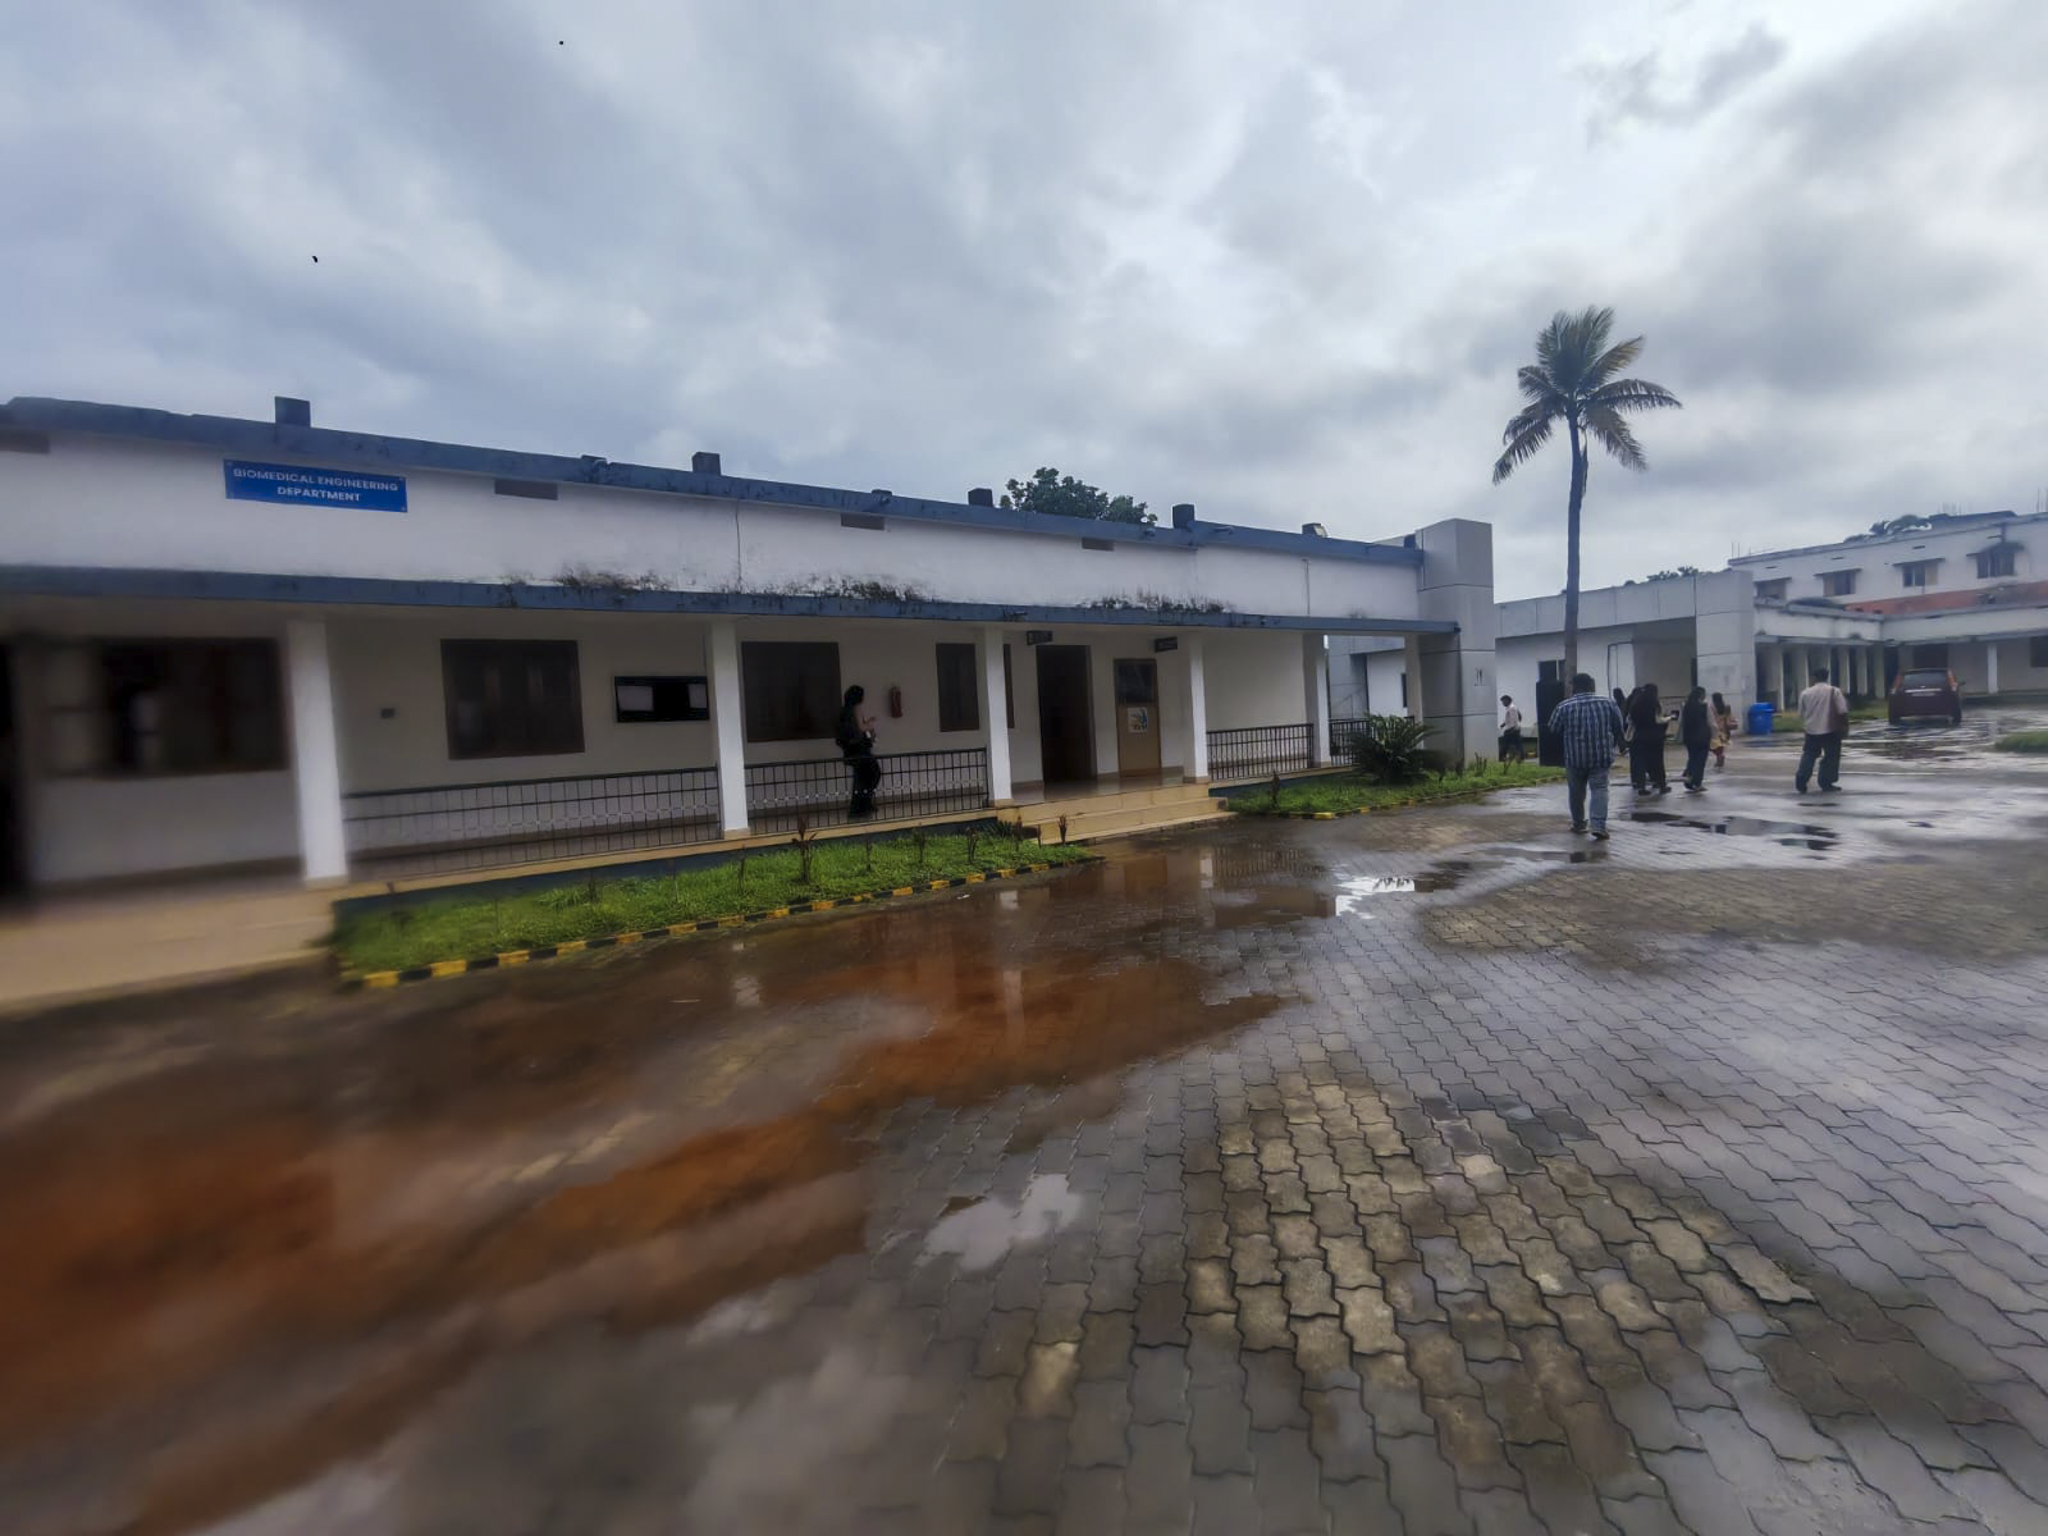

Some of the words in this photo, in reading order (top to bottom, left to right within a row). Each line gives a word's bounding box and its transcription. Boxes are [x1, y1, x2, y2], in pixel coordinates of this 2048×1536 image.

[233, 467, 315, 484] BIOMEDICAL
[317, 474, 399, 492] ENGINEERING
[277, 486, 362, 502] DEPARTMENT
